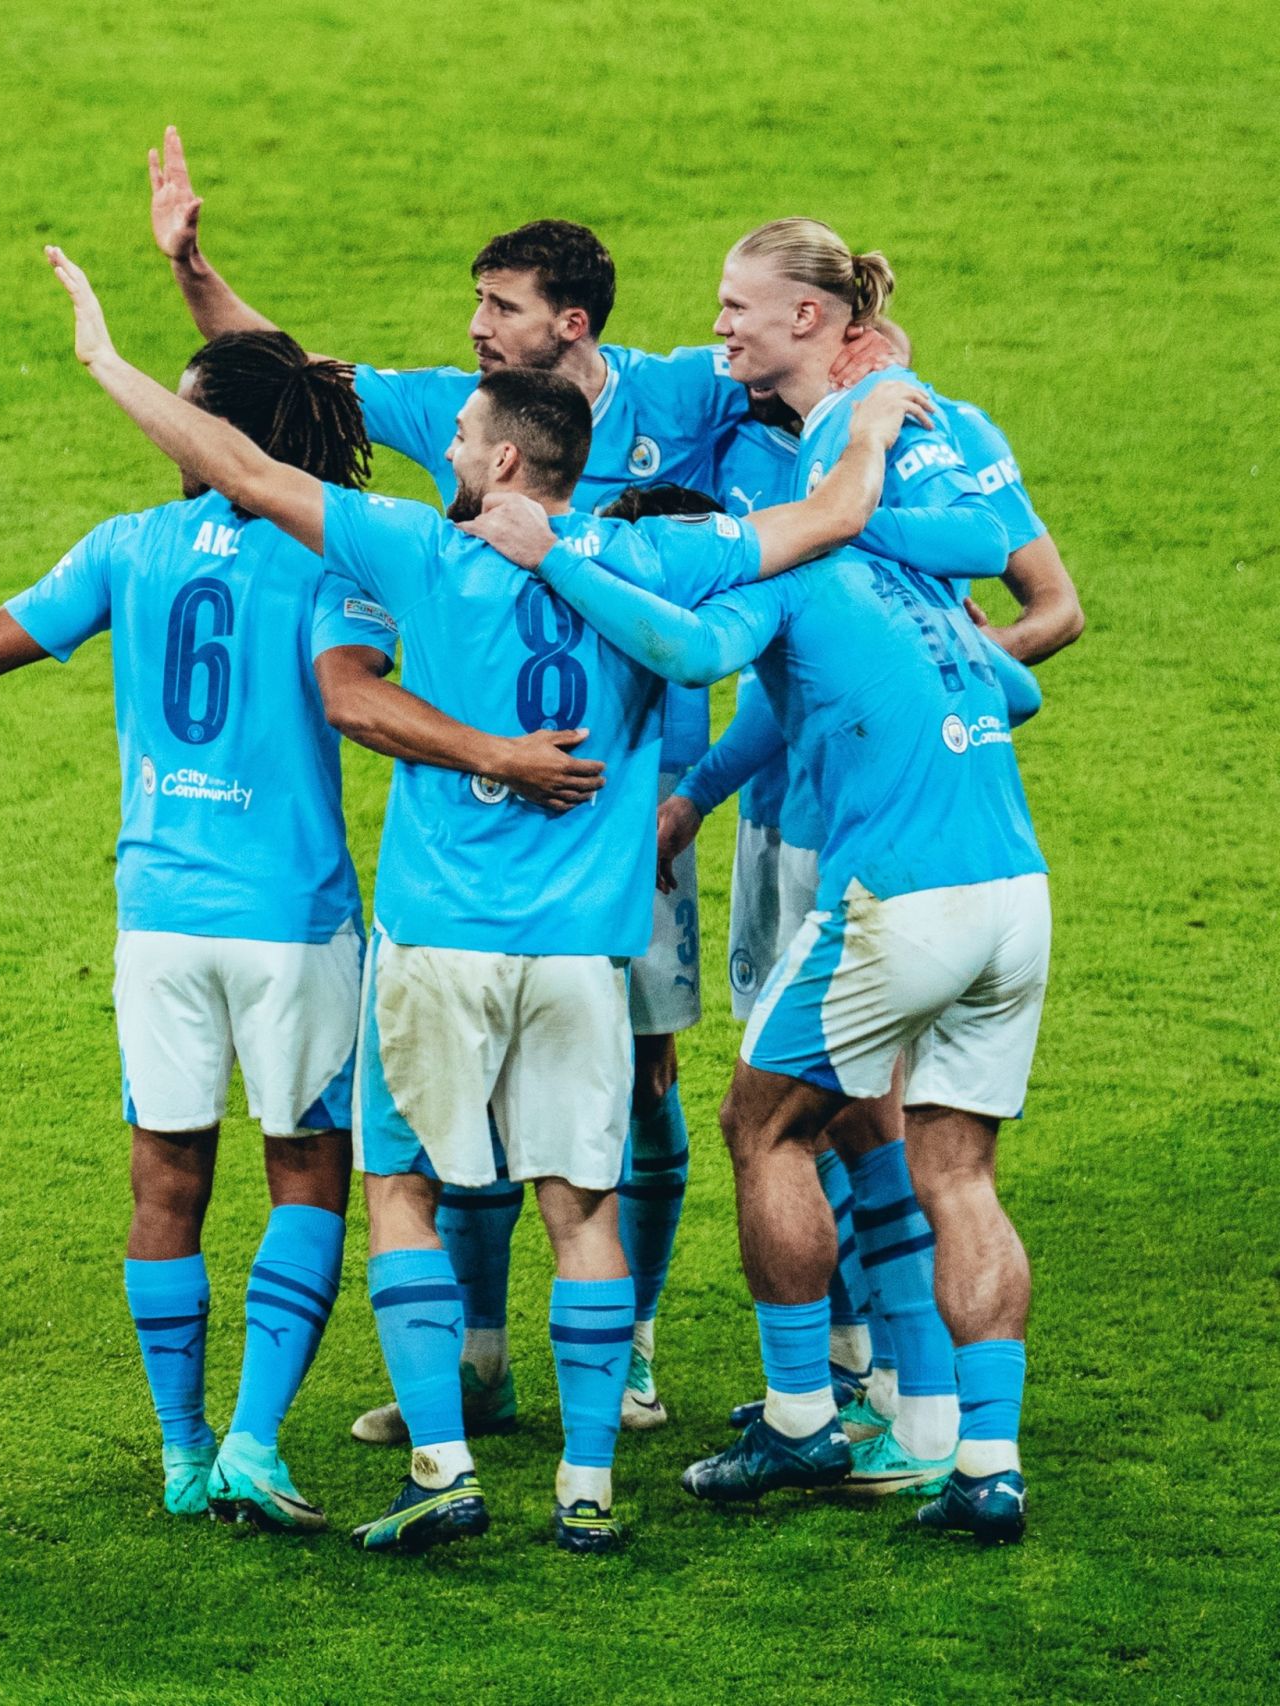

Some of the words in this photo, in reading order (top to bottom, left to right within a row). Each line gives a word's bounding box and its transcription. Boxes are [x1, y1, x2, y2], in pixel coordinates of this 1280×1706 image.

[976, 456, 1022, 495] OK
[163, 577, 234, 745] 6
[515, 576, 588, 734] 8
[161, 773, 253, 810] Community
[177, 768, 208, 786] City
